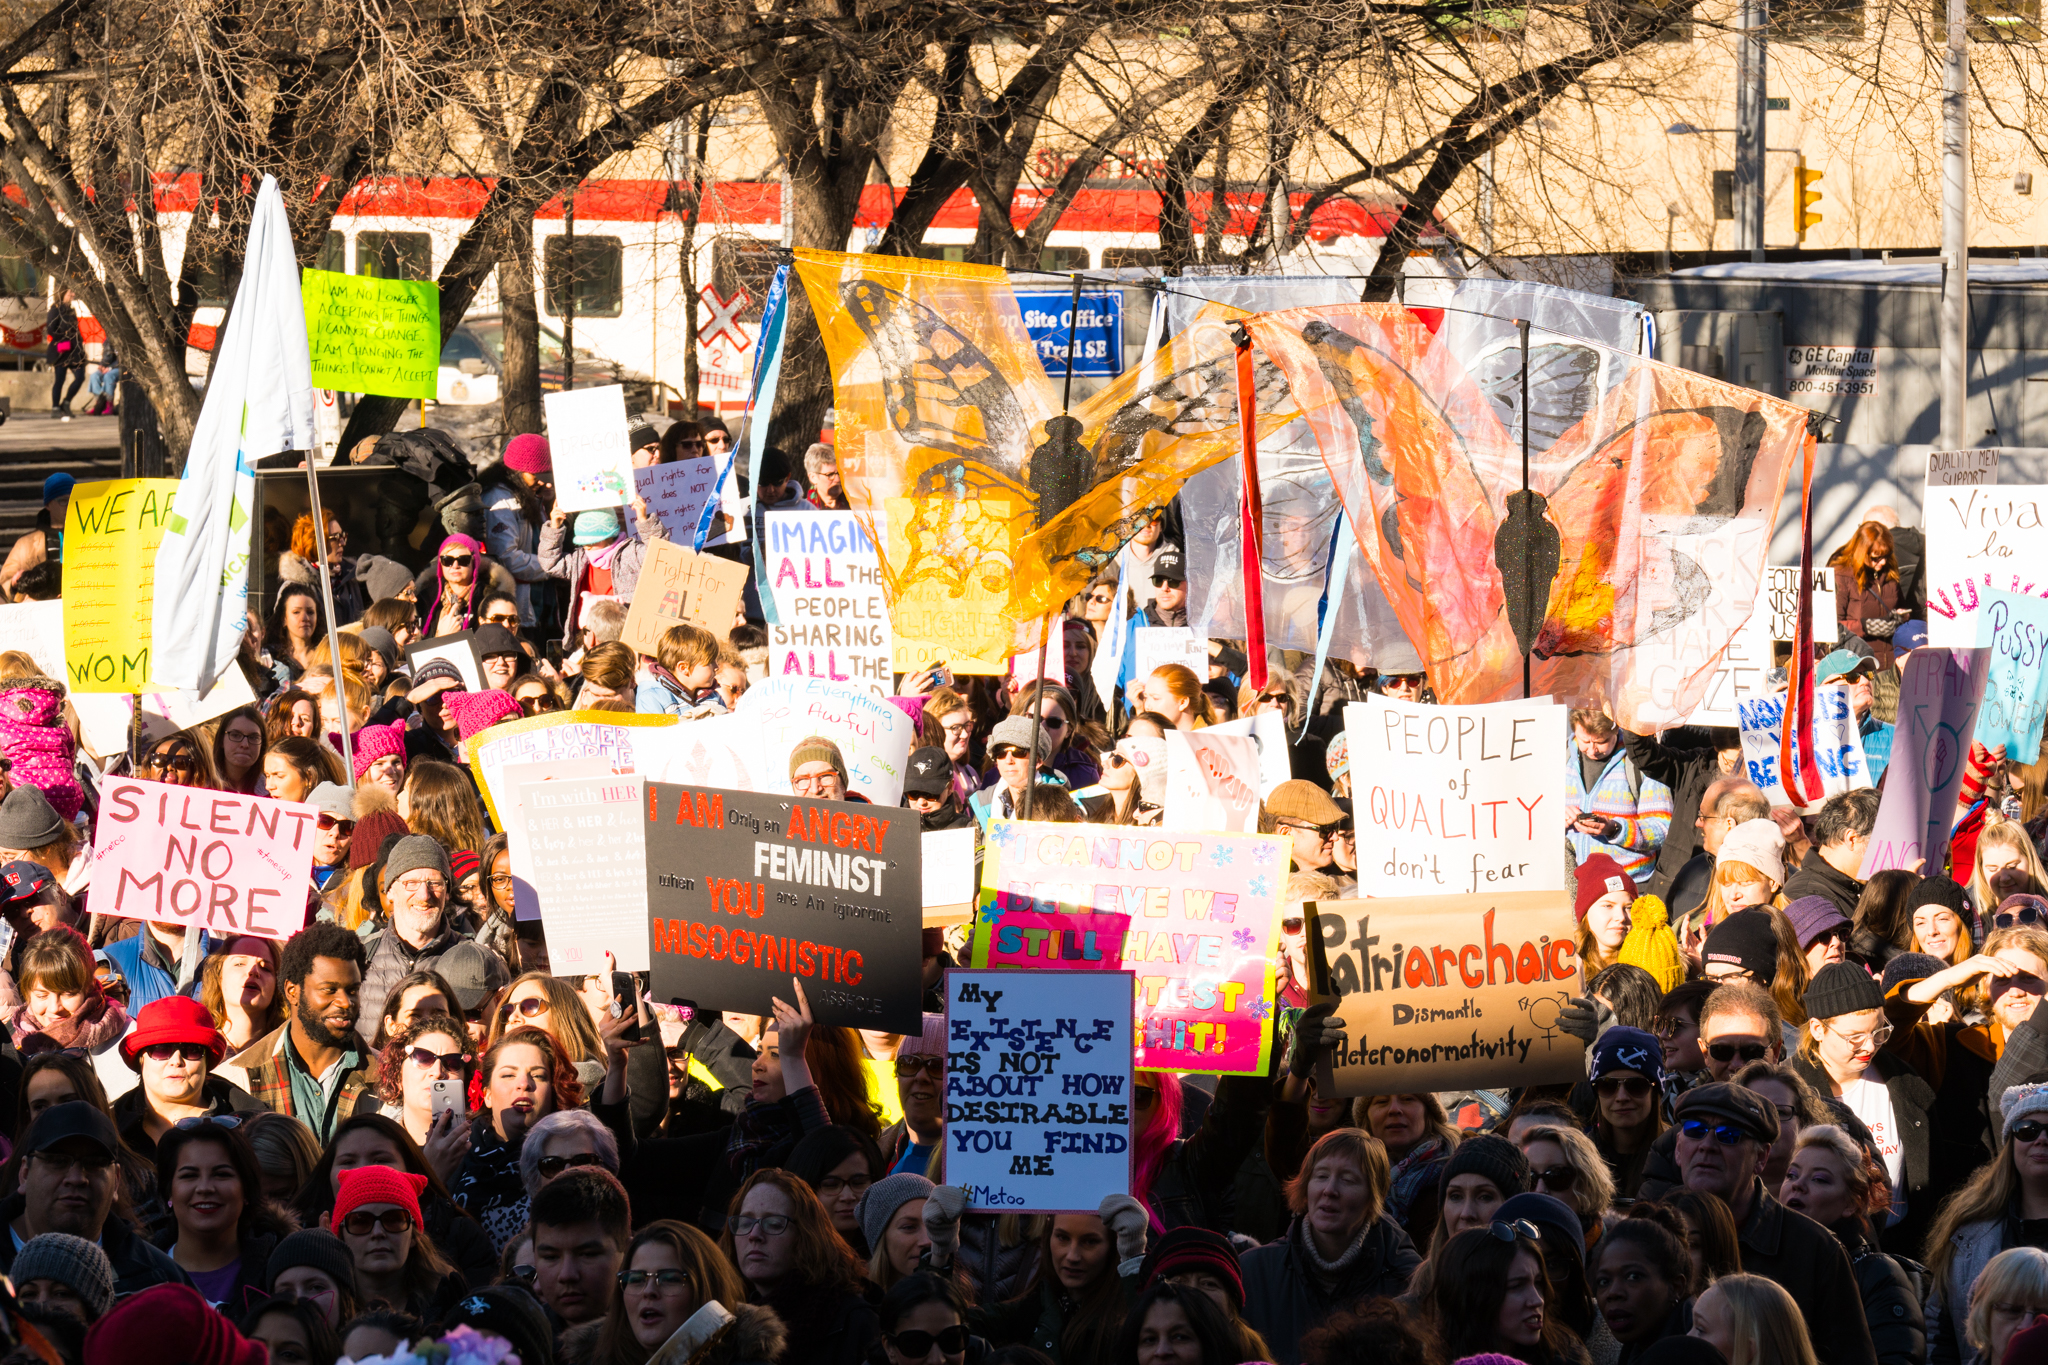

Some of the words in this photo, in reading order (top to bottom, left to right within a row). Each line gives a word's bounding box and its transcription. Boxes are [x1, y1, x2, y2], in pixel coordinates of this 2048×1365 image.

[321, 280, 325, 295] I
[330, 286, 348, 298] AM
[356, 288, 372, 300] NO
[377, 288, 419, 305] LONGER
[318, 303, 378, 320] ACCEPTING
[382, 308, 394, 322] THE
[396, 308, 430, 324] THINGS
[1024, 310, 1058, 329] Site
[317, 319, 321, 334] I
[326, 322, 368, 338] CANNOT
[315, 340, 320, 354] I
[324, 344, 342, 357] AM
[347, 343, 402, 358] CHANGING
[408, 349, 424, 360] THE
[712, 349, 723, 368] 2
[1085, 340, 1108, 359] SE
[1805, 348, 1824, 362] GE
[1826, 348, 1875, 366] Capital
[312, 358, 348, 374] THINGS
[352, 361, 355, 374] I
[360, 364, 394, 376] CANNOT
[1804, 364, 1845, 376] Modular
[1846, 365, 1876, 380] Space
[1789, 380, 1874, 394] 800-451-3951
[560, 430, 626, 456] DRAGON
[1930, 450, 1973, 472] QUALITY
[1978, 450, 2000, 467] MEN
[635, 470, 655, 494] qual
[661, 468, 686, 487] rights
[695, 464, 713, 474] for
[1942, 468, 1987, 485] SUPPORT
[662, 489, 678, 500] does
[690, 482, 708, 494] NOT
[75, 490, 136, 534] WE
[138, 490, 177, 530] AR
[674, 504, 696, 518] rights
[1949, 489, 2045, 530] Viva
[1967, 530, 2013, 558] la
[653, 548, 696, 588] Fight
[696, 561, 726, 594] for
[775, 556, 846, 590] ALL
[846, 564, 883, 586] THE
[658, 588, 707, 626] ALL
[794, 596, 882, 620] PEOPLE
[774, 624, 884, 647] SHARING
[900, 610, 1002, 642] LIGHT
[67, 648, 148, 684] WOM
[782, 650, 850, 682] ALL
[848, 655, 891, 681] THE
[896, 646, 908, 663] in
[918, 646, 943, 664] our
[1912, 652, 1990, 698] TRANS
[805, 679, 894, 732] Everything
[1978, 678, 2042, 739] POWER
[482, 732, 536, 768] THE
[547, 724, 633, 748] POWER
[1384, 710, 1536, 762] PEOPLE
[850, 763, 873, 785] to
[870, 756, 900, 782] even
[532, 791, 558, 807] I'm
[560, 787, 598, 804] with
[601, 785, 638, 802] HER
[1448, 768, 1472, 800] of
[108, 785, 315, 852] SILENT
[528, 818, 538, 832] &
[542, 817, 560, 830] HER
[563, 816, 574, 830] &
[577, 815, 602, 829] HER
[649, 786, 658, 822] I
[676, 790, 724, 830] AM
[728, 809, 760, 834] Only
[764, 819, 780, 834] an
[1370, 785, 1544, 841] QUALITY
[164, 834, 233, 880] NO
[256, 848, 292, 882] #timesup
[1014, 834, 1028, 864] I
[1037, 834, 1202, 872] CANNOT
[1384, 847, 1446, 885] don't
[1470, 853, 1531, 893] fear
[114, 867, 282, 936] MORE
[658, 872, 695, 890] when
[705, 876, 765, 919] YOU
[776, 891, 798, 906] are
[806, 894, 825, 911] An
[832, 896, 892, 924] ignorant
[1183, 889, 1239, 924] WE
[551, 948, 561, 961] &
[564, 948, 583, 960] YOU
[653, 918, 864, 986] MISOGYNISTIC
[997, 925, 1102, 962] STILL
[1120, 930, 1224, 968] HAVE
[1312, 907, 1576, 996] Patriarchaic
[818, 989, 883, 1014] ASSHOLE
[958, 982, 1003, 1012] MY
[1392, 997, 1482, 1026] Dismantle
[951, 1018, 1114, 1053] EXISTENCE
[1332, 1025, 1532, 1069] Heteronormativity
[948, 1052, 981, 1075] IS
[998, 1052, 1060, 1075] NOT
[948, 1074, 1044, 1098] ABOUT
[1062, 1073, 1125, 1096] HOW
[947, 1101, 1129, 1124] DESIRABLE
[952, 1130, 1012, 1153] YOU
[1044, 1131, 1128, 1154] FIND
[1008, 1155, 1054, 1176] ME
[960, 1182, 1026, 1206] #Metoo
